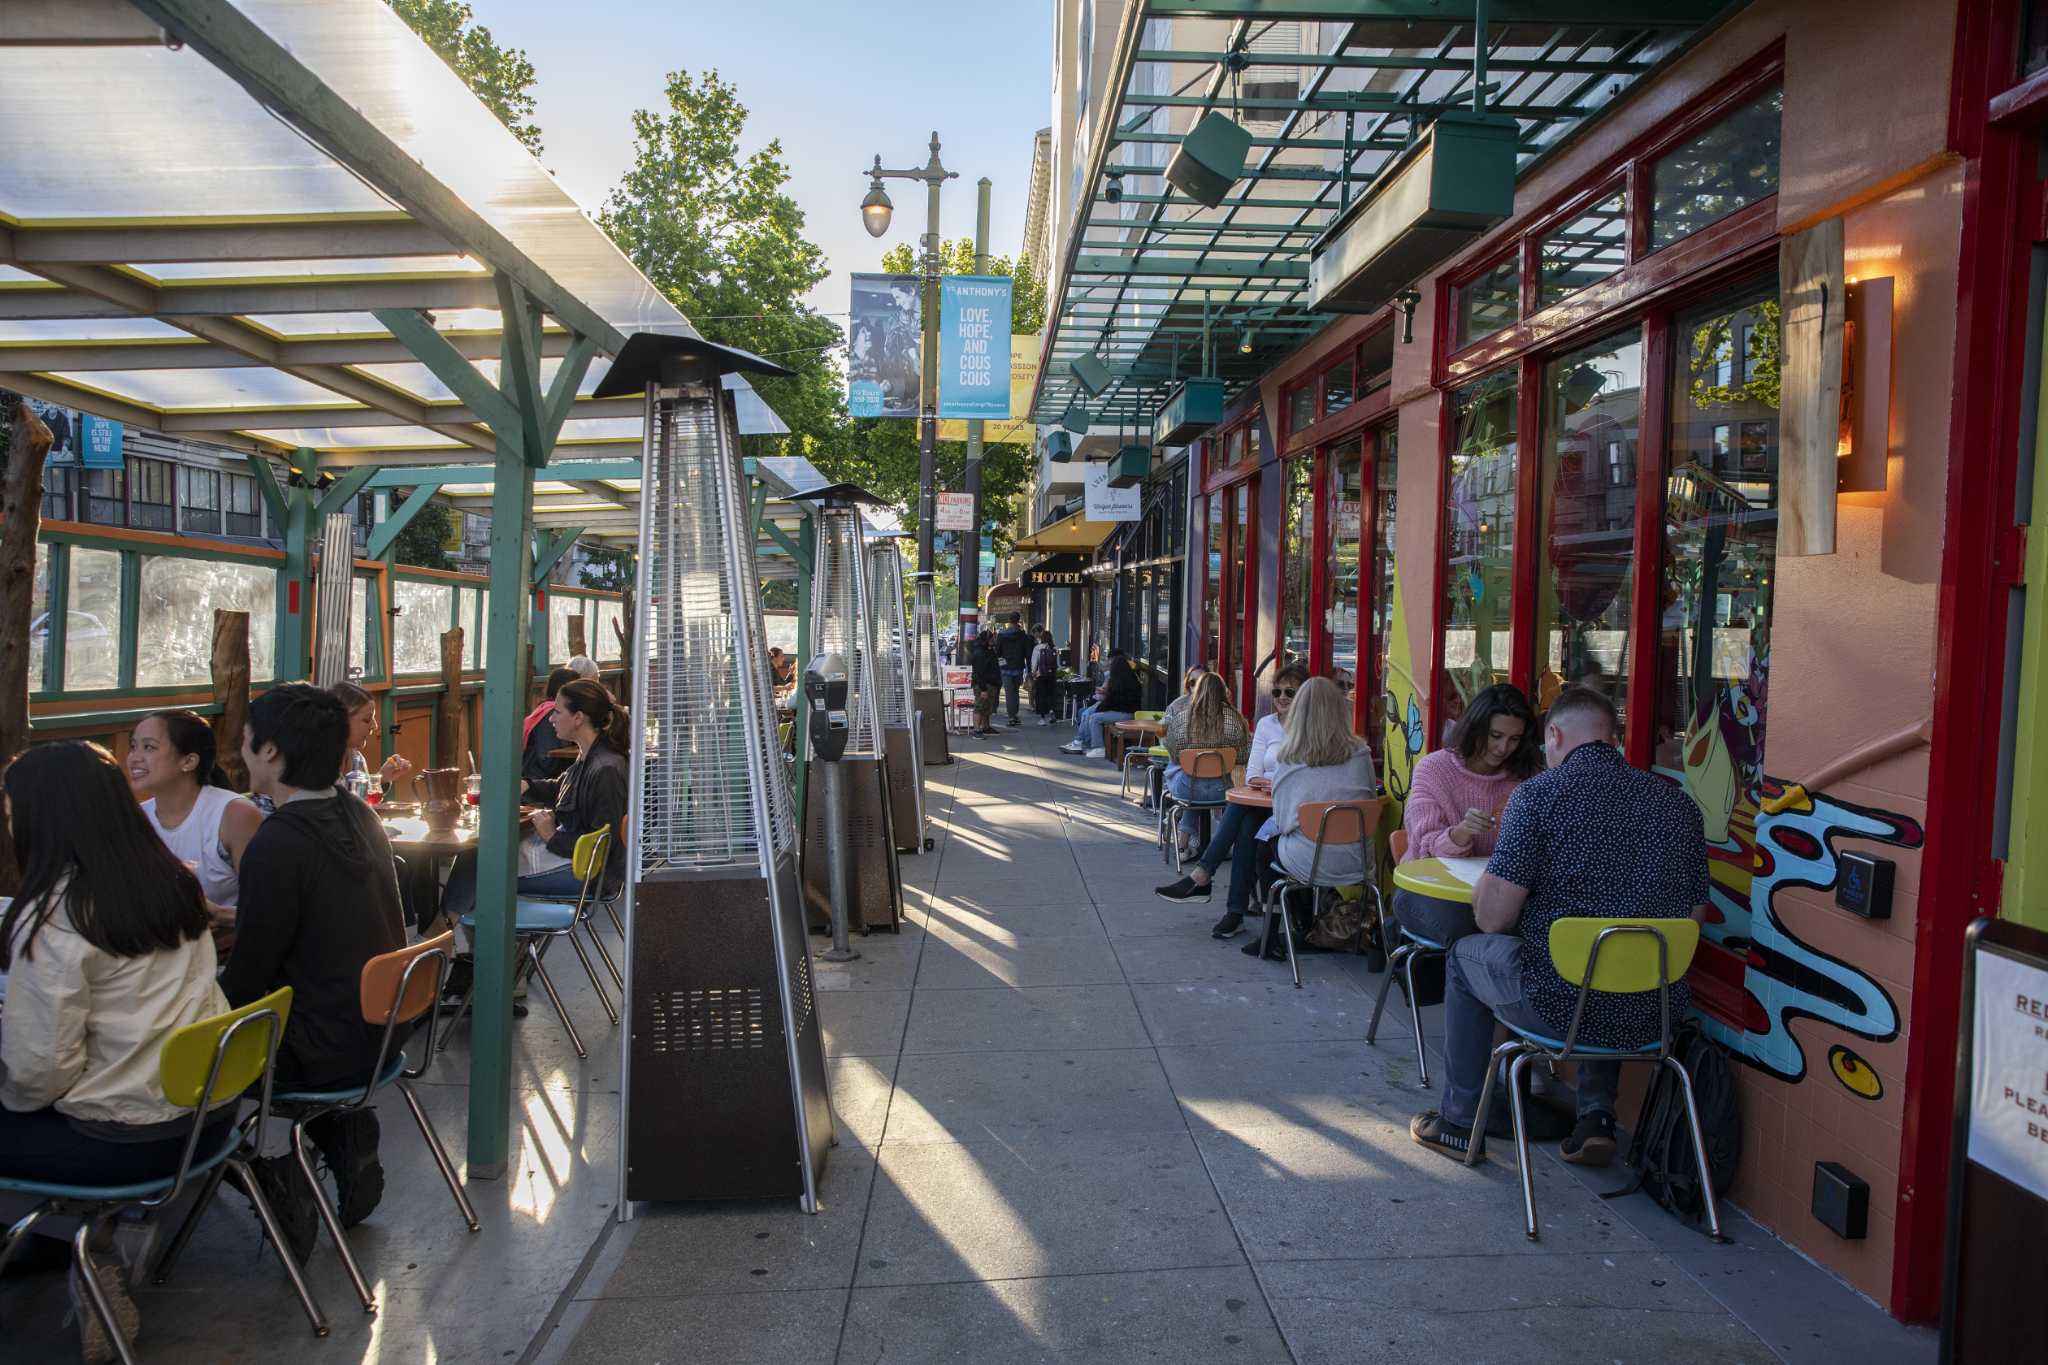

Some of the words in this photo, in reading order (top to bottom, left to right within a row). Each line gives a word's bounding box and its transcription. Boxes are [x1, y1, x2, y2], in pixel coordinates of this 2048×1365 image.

[957, 287, 1007, 297] ANTHONY'S
[960, 307, 992, 323] LOVE,
[959, 324, 993, 340] HOPE,
[964, 340, 987, 354] AND
[960, 356, 991, 370] COUS
[960, 371, 991, 386] COUS
[1031, 571, 1083, 584] HOTEL
